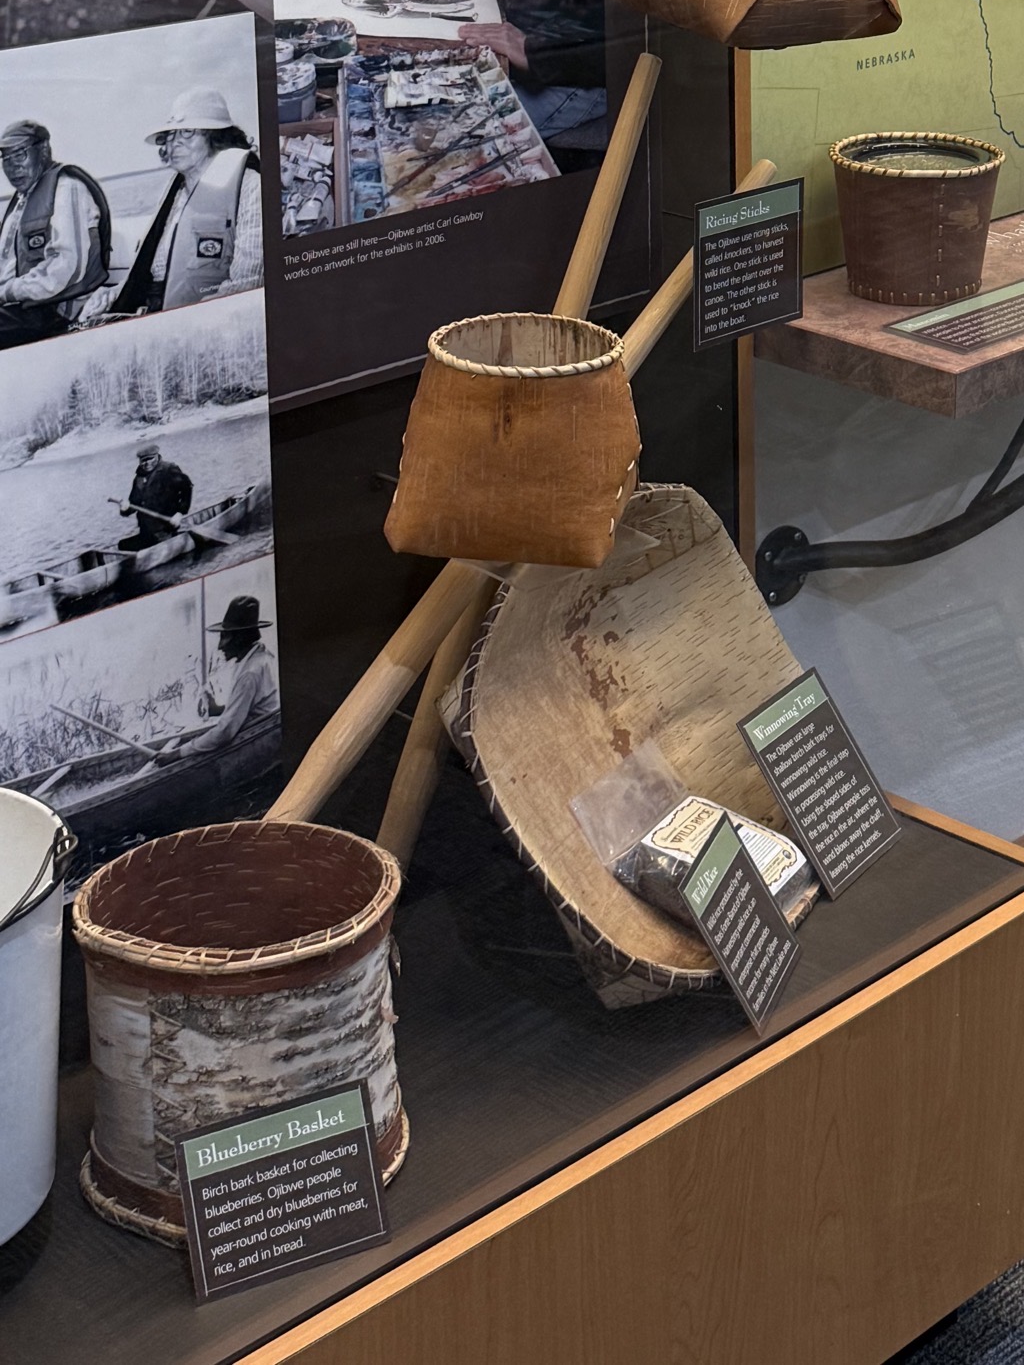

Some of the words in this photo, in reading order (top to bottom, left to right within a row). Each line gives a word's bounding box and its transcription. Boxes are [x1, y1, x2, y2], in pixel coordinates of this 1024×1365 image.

[856, 48, 917, 72] NEBRASKA
[283, 255, 300, 266] The
[301, 248, 330, 263] Ojibwe
[331, 244, 345, 255] are
[345, 238, 359, 252] still
[416, 222, 435, 234] artist
[436, 216, 452, 229] Carl
[453, 211, 484, 225] Gawboy
[705, 212, 739, 230] Ricing
[740, 200, 770, 221] Sticks
[753, 705, 800, 741] Winnowing
[795, 692, 816, 713] Tray
[197, 1132, 283, 1168] Blueberry
[287, 1109, 346, 1140] Basket
[202, 1182, 229, 1201] Birch
[230, 1174, 255, 1192] bark
[256, 1163, 291, 1183] basket
[292, 1158, 308, 1172] for
[309, 1143, 358, 1166] collecting
[204, 1192, 265, 1219] blueberries.
[267, 1179, 304, 1200] Ojibwe
[306, 1166, 342, 1189] people
[207, 1218, 242, 1238] collect
[244, 1208, 265, 1227] and
[266, 1205, 283, 1219] dry
[284, 1186, 341, 1213] blueberries
[342, 1181, 358, 1194] for
[210, 1227, 268, 1259] year-round
[269, 1216, 312, 1238] cooking
[312, 1206, 337, 1223] with
[338, 1197, 368, 1215] meat,
[214, 1262, 236, 1276] rice,
[238, 1250, 259, 1268] and
[260, 1248, 271, 1261] in
[272, 1235, 306, 1257] bread.
